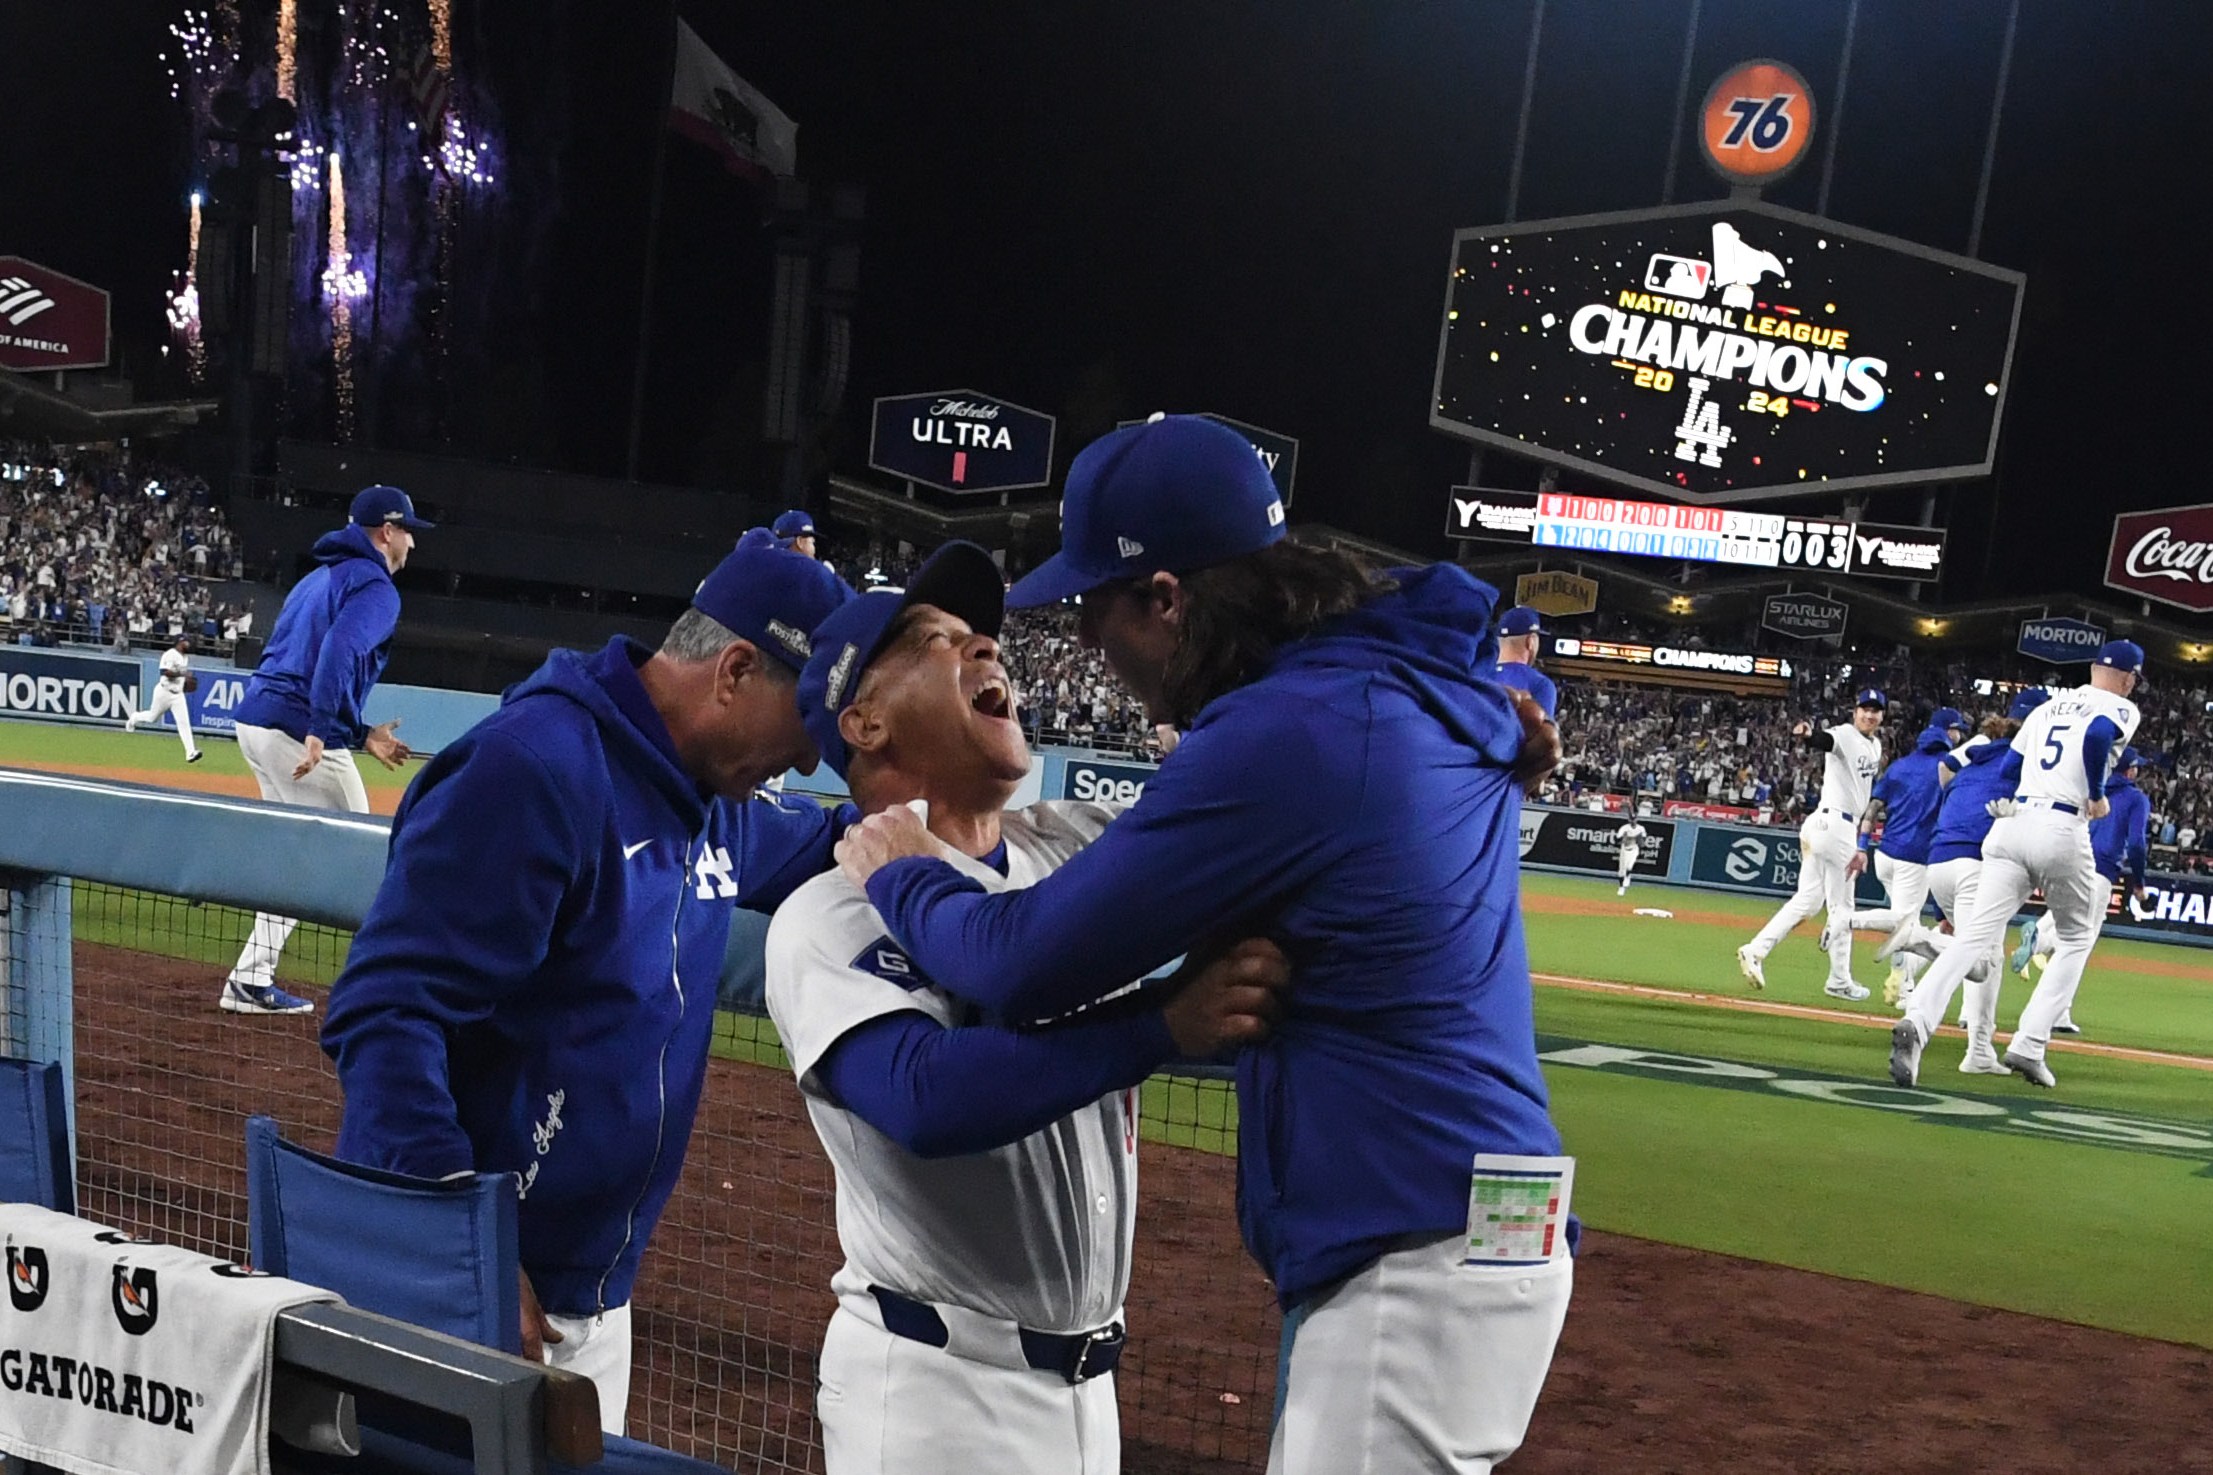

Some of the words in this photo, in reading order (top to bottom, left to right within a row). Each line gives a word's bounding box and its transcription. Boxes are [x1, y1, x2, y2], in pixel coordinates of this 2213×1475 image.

[1718, 93, 1796, 153] 76
[1619, 290, 1737, 329] NATIONAL
[1744, 314, 1850, 350] LEAGUE
[13, 336, 69, 354] AMERICA
[1569, 304, 1888, 412] CHAMPIONS
[929, 399, 1000, 419] Michelob
[1675, 377, 1731, 468] LA
[912, 417, 1012, 451] ULTRA
[1769, 602, 1842, 620] STARLUX
[2024, 625, 2101, 647] MORTON
[1653, 647, 1753, 673] CHAMPIONS
[2040, 725, 2071, 770] 5
[2129, 886, 2213, 925] CHA
[0, 1350, 194, 1434] GATORADE
